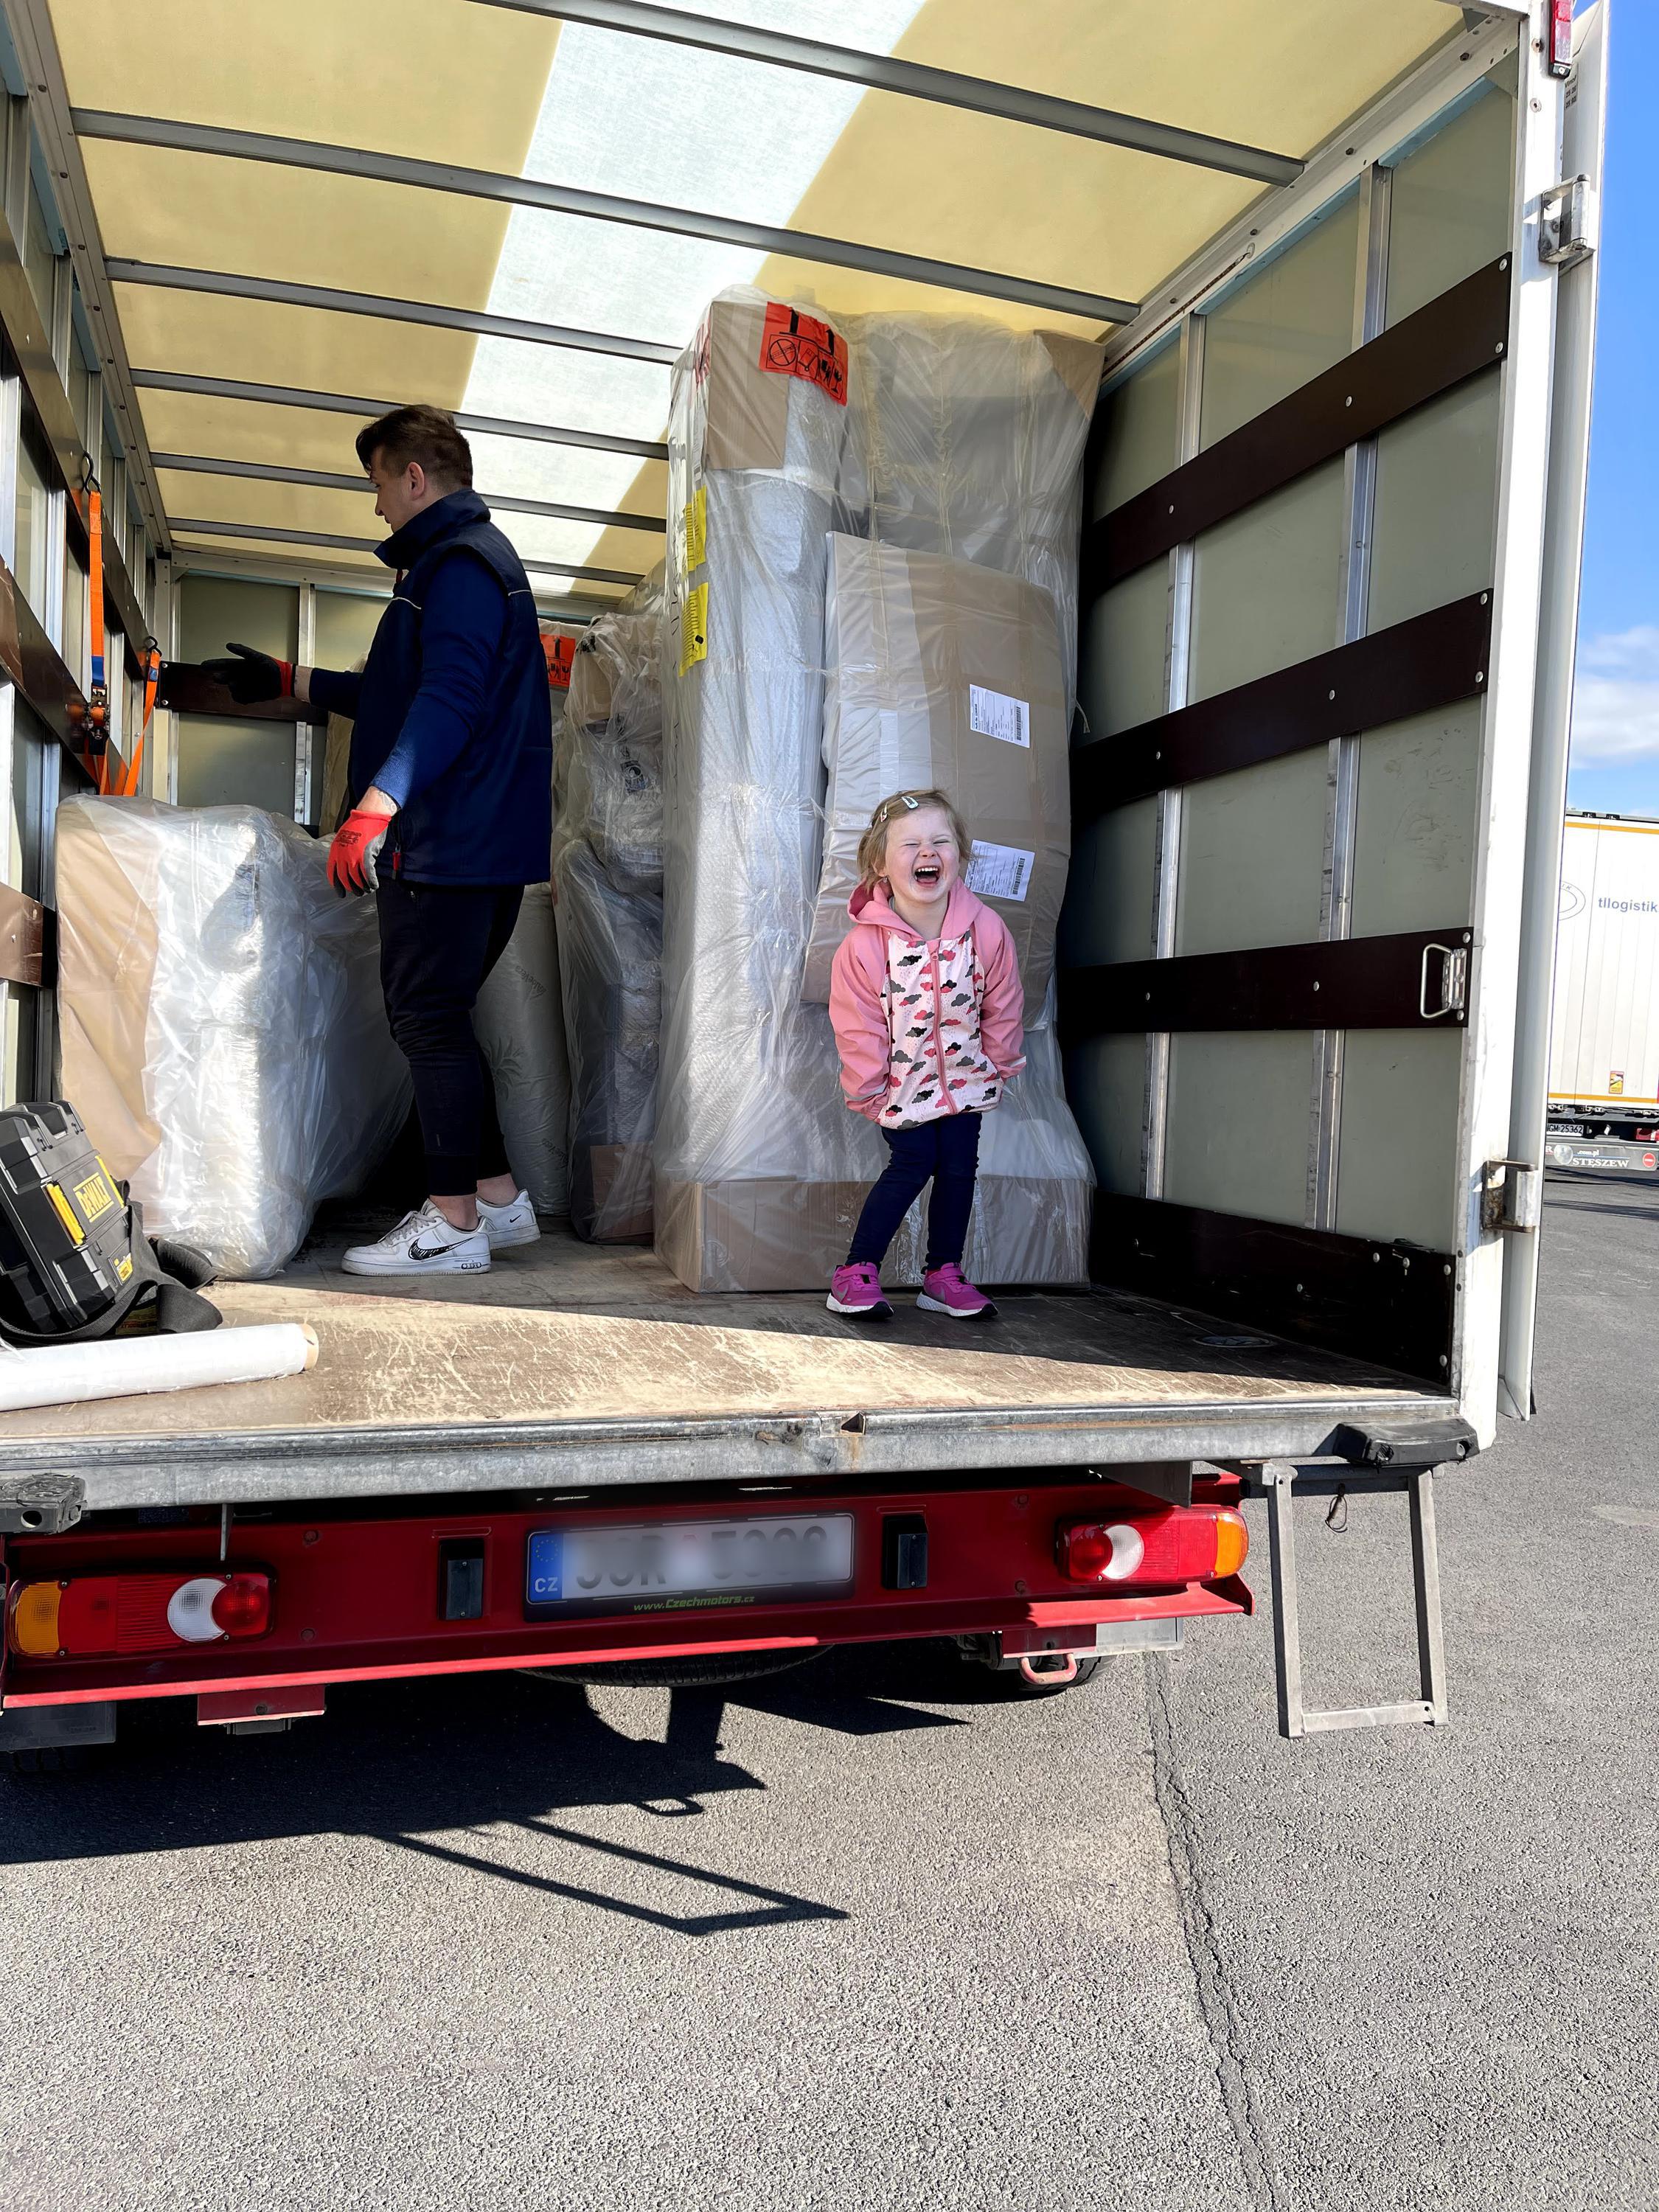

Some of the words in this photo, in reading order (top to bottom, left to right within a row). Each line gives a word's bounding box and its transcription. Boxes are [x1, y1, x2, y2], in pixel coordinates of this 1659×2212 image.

[1598, 897, 1658, 913] tllogistik
[1560, 1124, 1583, 1134] 25362
[535, 1576, 558, 1593] CZ
[633, 1595, 755, 1611] www.Czechmotors.cz
